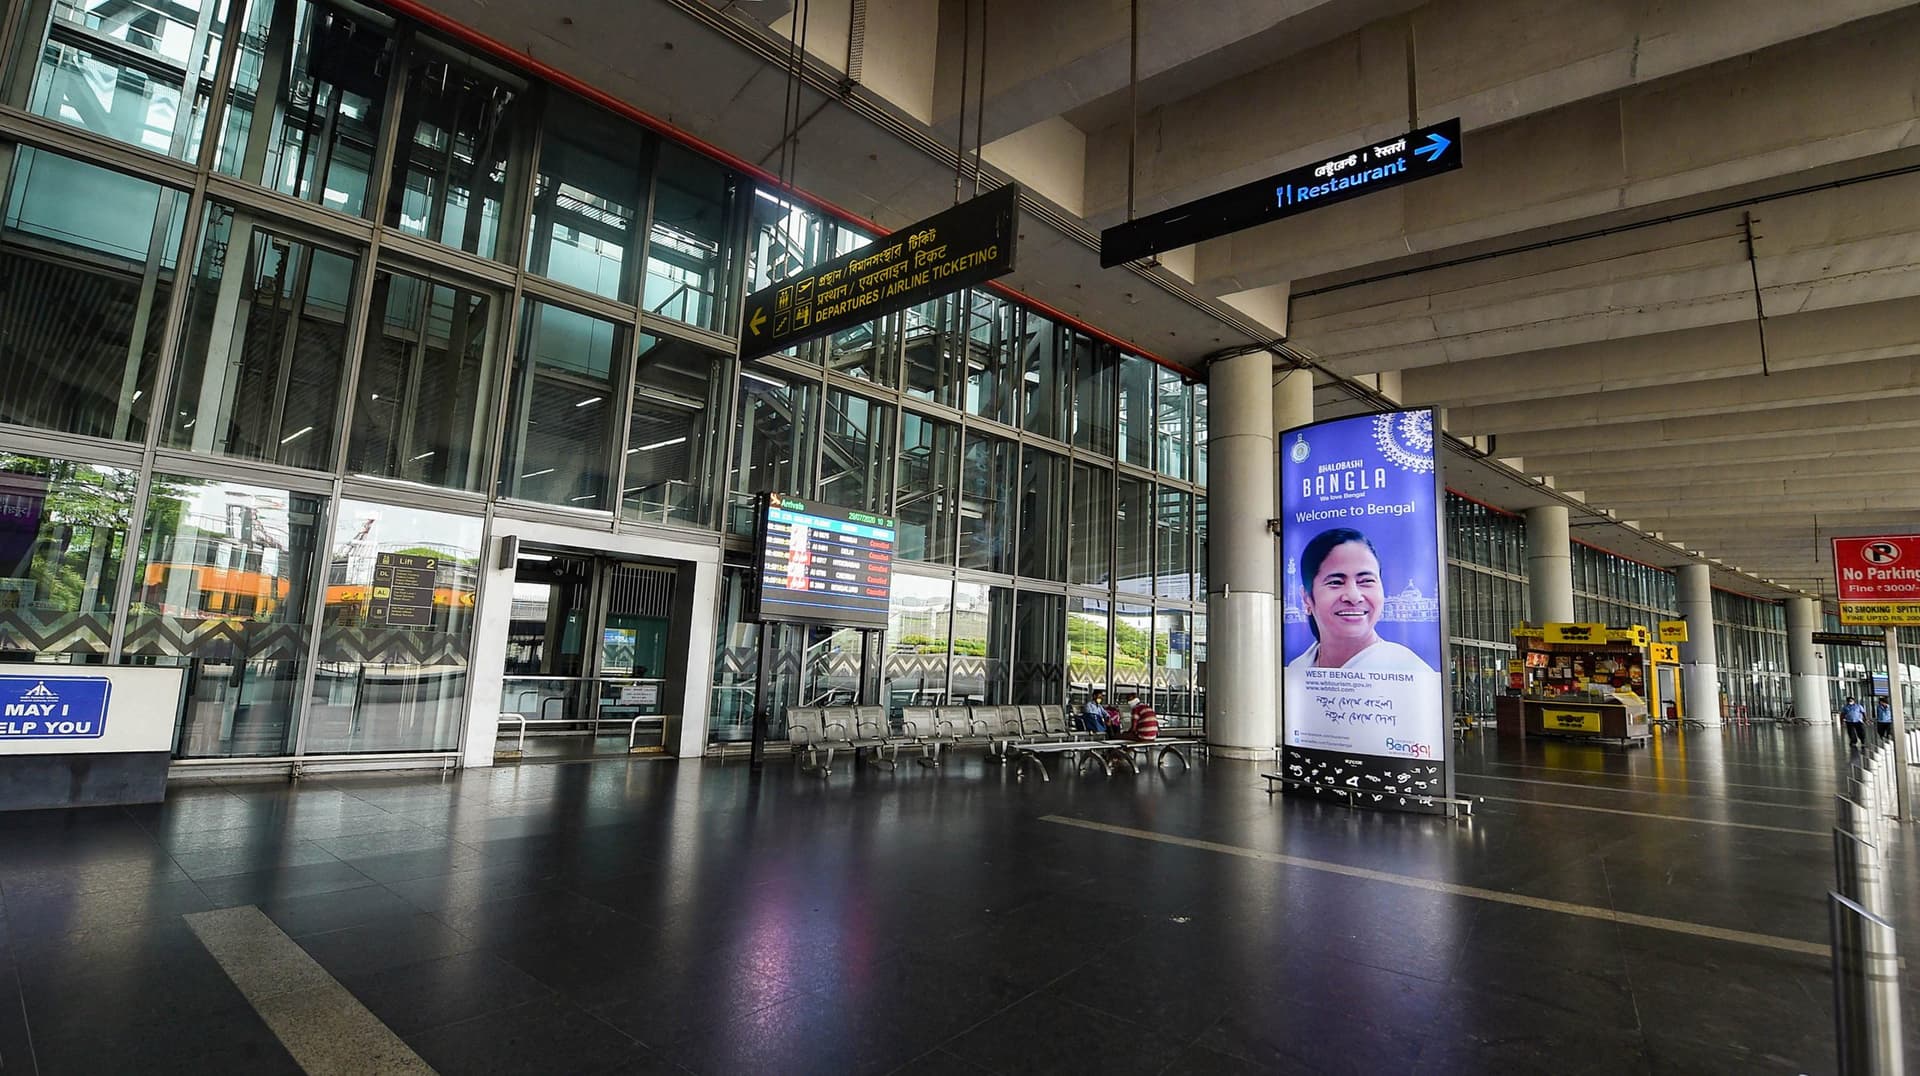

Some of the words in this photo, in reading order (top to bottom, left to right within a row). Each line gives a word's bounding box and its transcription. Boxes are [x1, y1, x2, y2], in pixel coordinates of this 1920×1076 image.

[1297, 158, 1407, 202] Restaurant
[908, 228, 937, 251] টিকিট
[817, 284, 848, 306] प्रस्थान
[859, 260, 908, 291] एयरलाइन
[915, 244, 947, 269] टिकट
[815, 289, 880, 323] DEPARTURES
[886, 269, 930, 298] AIRLINE
[932, 245, 998, 280] TICKETING
[1318, 459, 1363, 474] BHALOBASHI
[1303, 467, 1386, 498] BANGLA
[1343, 491, 1366, 500] Bengal
[1296, 509, 1347, 523] Welcome
[1350, 505, 1364, 516] to
[1367, 500, 1416, 517] Bengal
[400, 558, 413, 566] Lift
[426, 558, 435, 569] 2
[1843, 567, 1863, 580] No
[1867, 566, 1920, 582] Parking
[1849, 584, 1874, 592] Fine
[1306, 670, 1328, 678] WEST
[1329, 671, 1366, 680] BENGAL
[1368, 672, 1414, 682] TOURISM
[5, 703, 56, 716] MAY
[61, 703, 69, 716] I
[45, 721, 91, 734] YOU
[1385, 737, 1431, 758] Bengal
